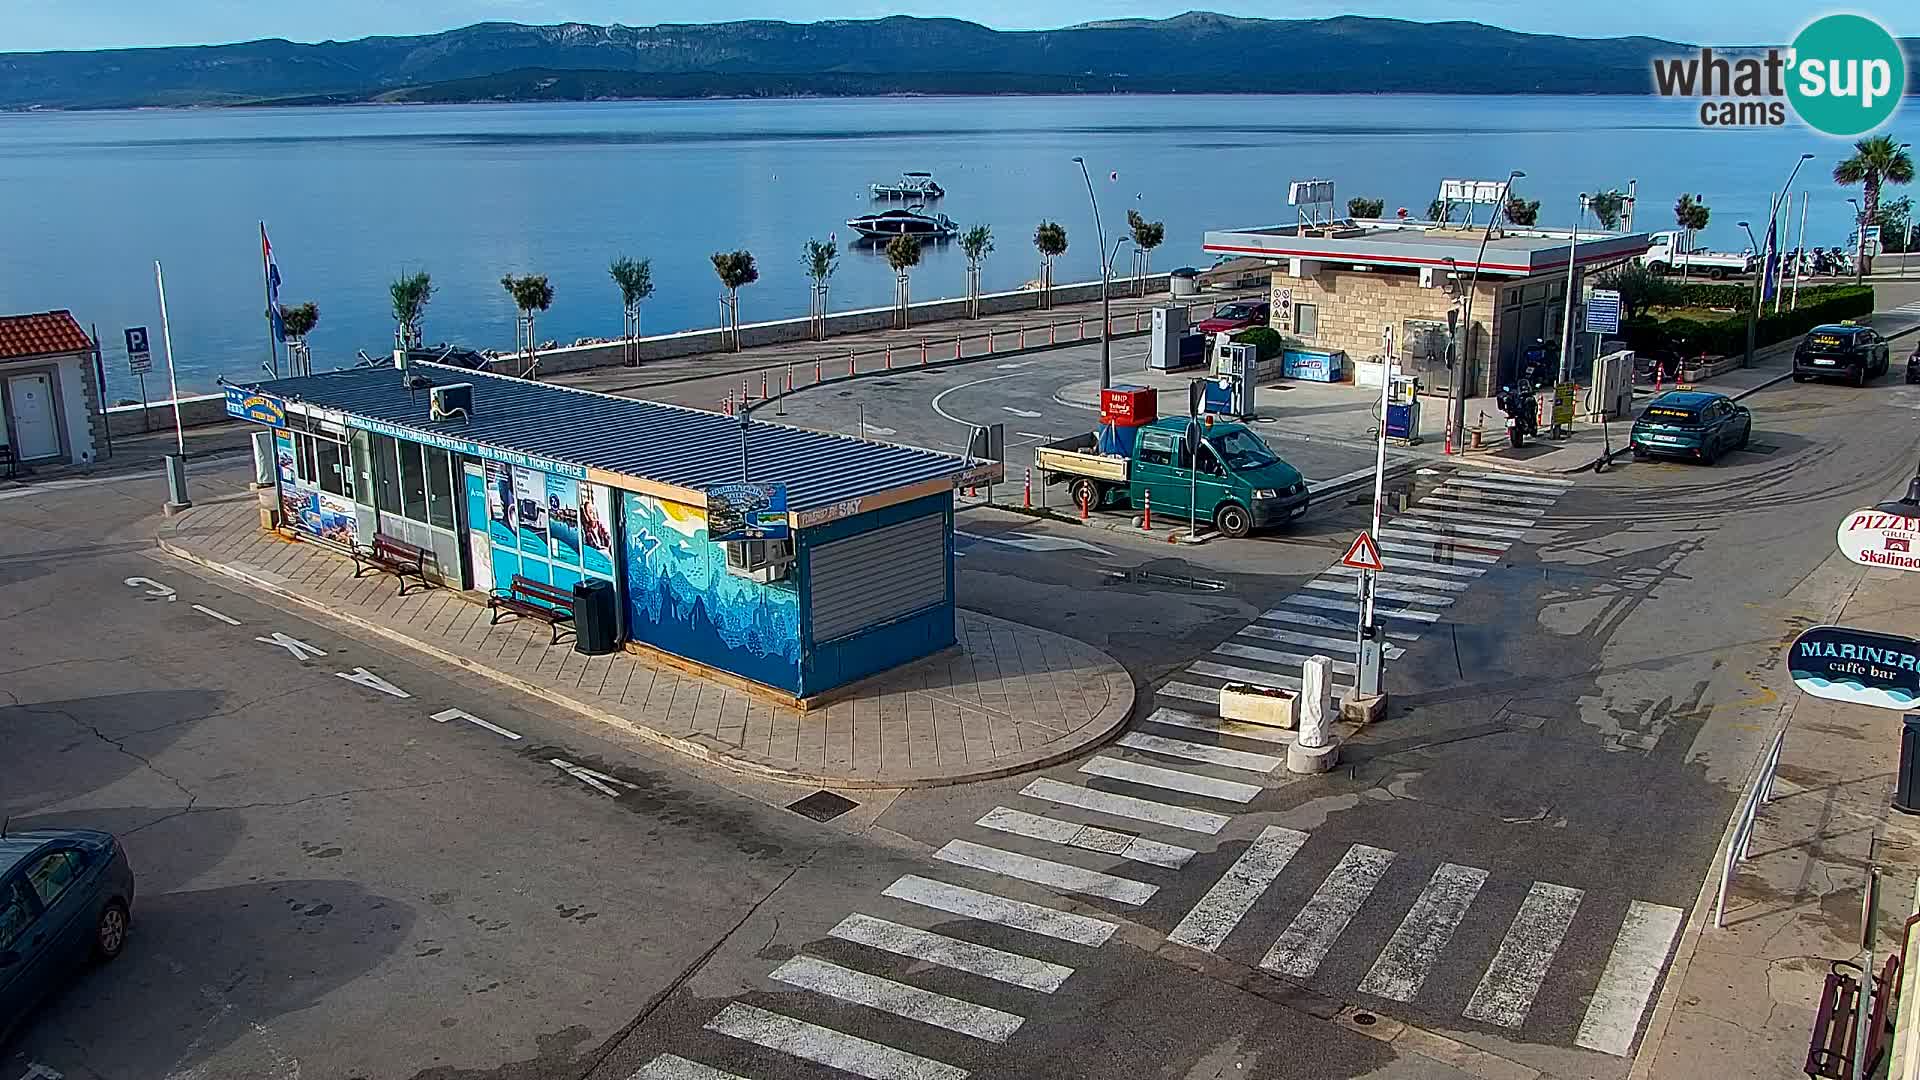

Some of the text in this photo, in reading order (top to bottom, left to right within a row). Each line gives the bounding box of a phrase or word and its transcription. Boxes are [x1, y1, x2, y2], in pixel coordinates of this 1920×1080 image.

[130, 331, 142, 350] P
[435, 436, 468, 452] POSTAJA
[478, 445, 493, 458] BUS
[494, 449, 527, 464] STATION
[528, 456, 556, 471] TICKET
[555, 463, 583, 477] OFFICE
[1882, 530, 1917, 540] GRILL
[1829, 661, 1897, 680] caffe bar
